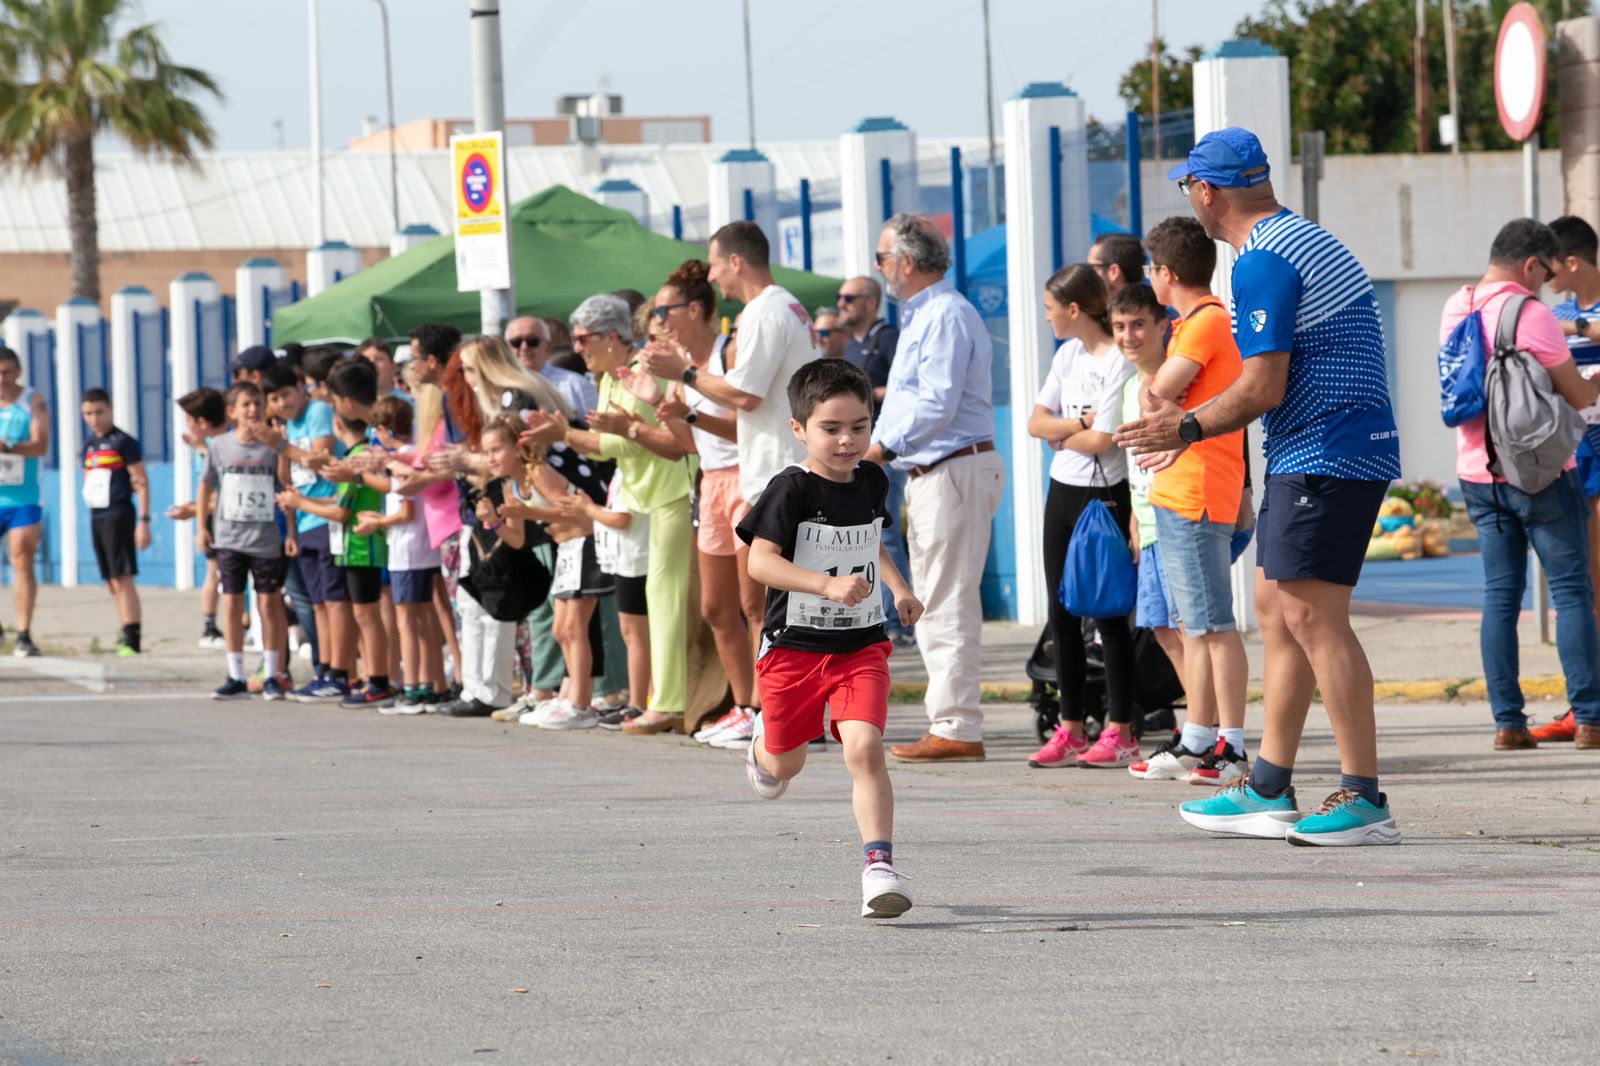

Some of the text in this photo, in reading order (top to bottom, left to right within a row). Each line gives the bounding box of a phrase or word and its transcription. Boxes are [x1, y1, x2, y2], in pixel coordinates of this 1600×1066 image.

[1370, 431, 1389, 440] CLUB
[238, 492, 267, 508] 152
[806, 527, 822, 542] II
[815, 544, 854, 552] POPULAR
